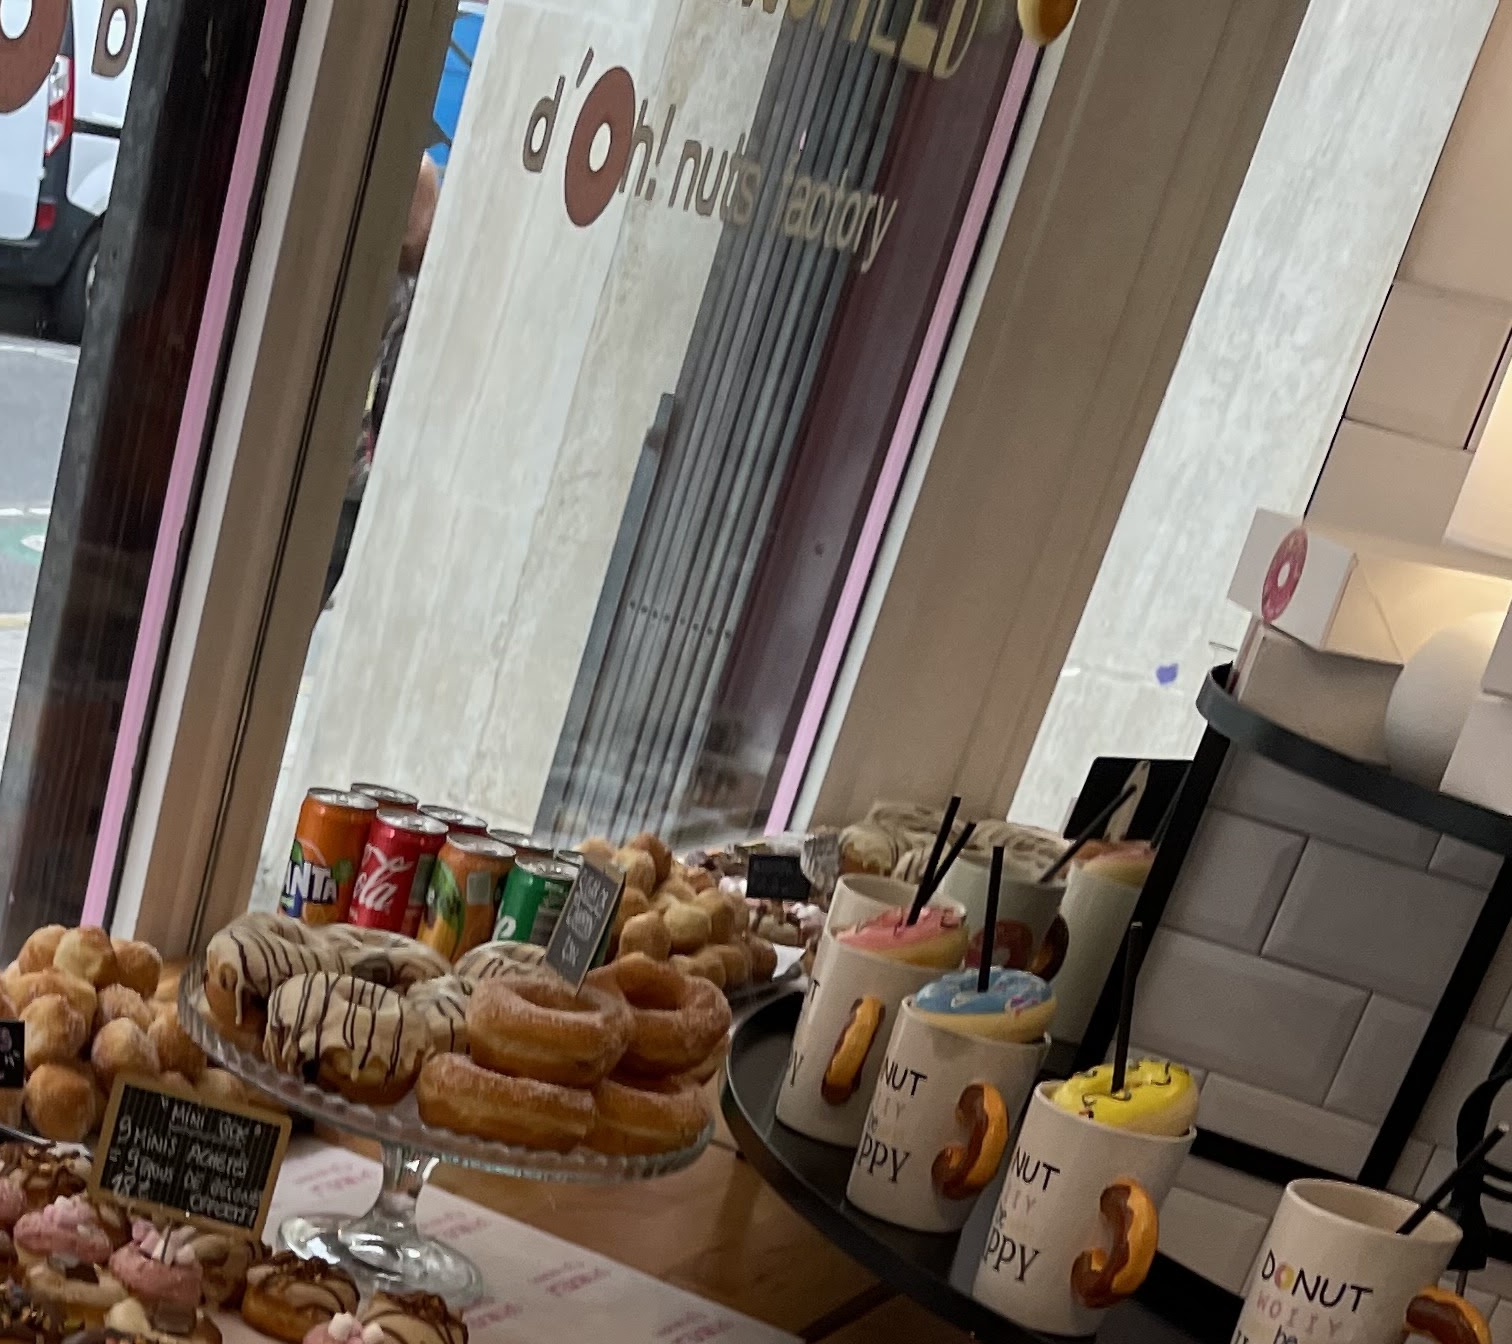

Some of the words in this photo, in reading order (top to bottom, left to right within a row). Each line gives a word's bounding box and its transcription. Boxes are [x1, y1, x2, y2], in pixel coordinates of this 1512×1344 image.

[668, 132, 761, 226] nuts
[772, 162, 898, 273] factory
[1261, 1249, 1374, 1312] DONUT
